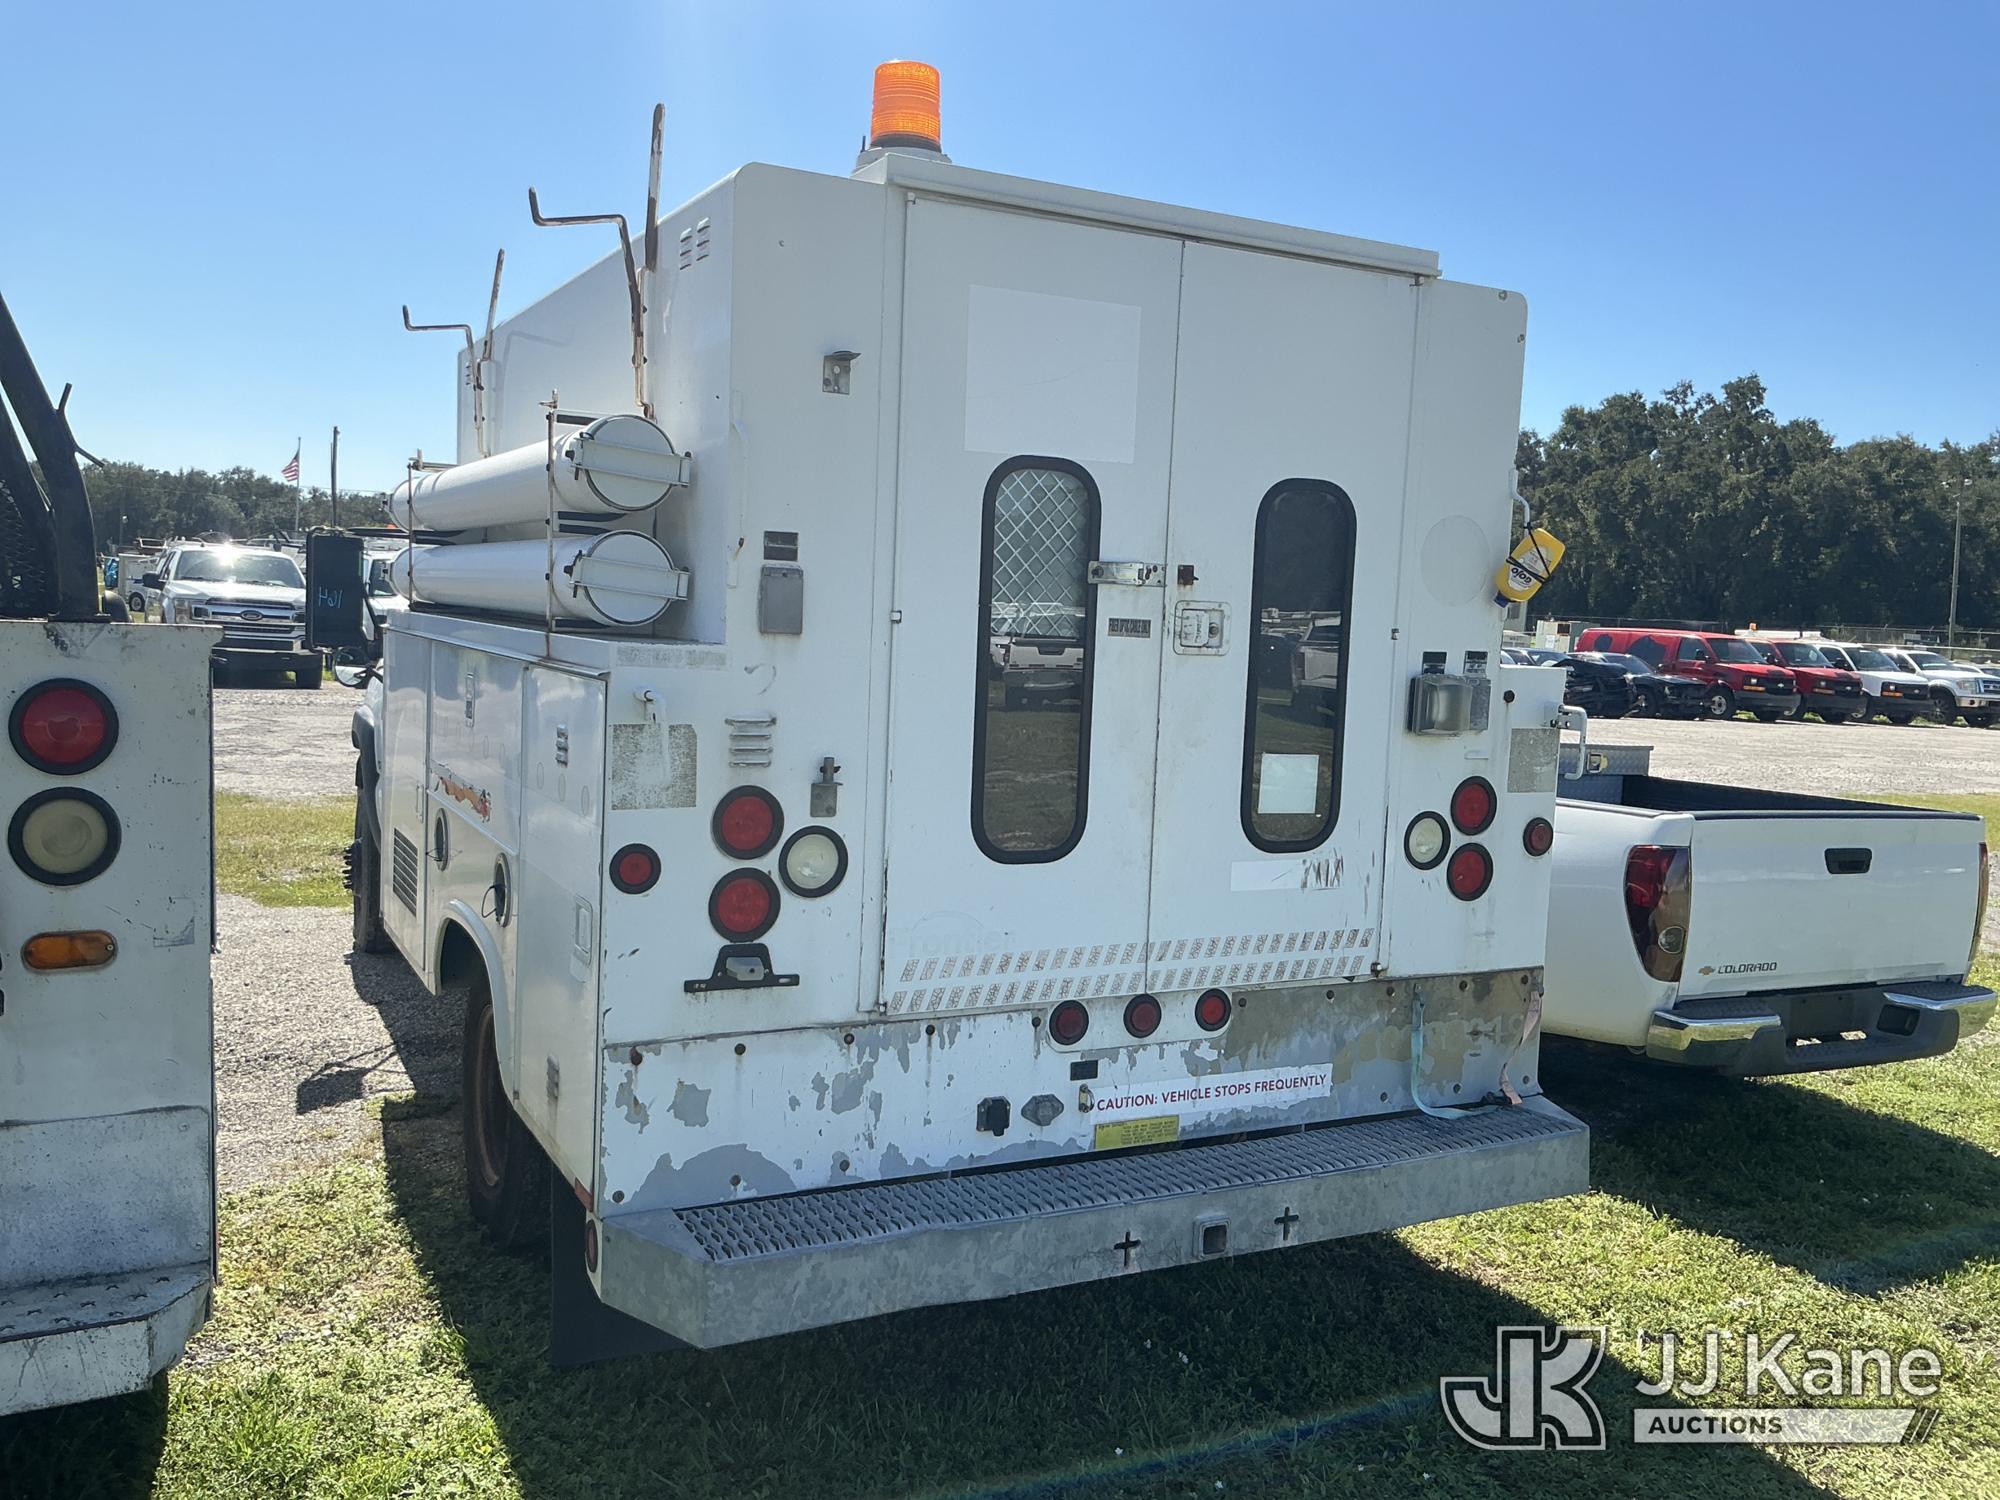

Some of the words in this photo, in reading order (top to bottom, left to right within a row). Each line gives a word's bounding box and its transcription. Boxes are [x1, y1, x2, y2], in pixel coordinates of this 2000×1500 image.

[1717, 962, 1777, 975] COLORADO
[1097, 1094, 1158, 1111] CAUTION:
[1161, 1087, 1211, 1104] VEHICLE
[1215, 1082, 1251, 1098] STOPS
[1254, 1074, 1327, 1094] FREQUENTLY
